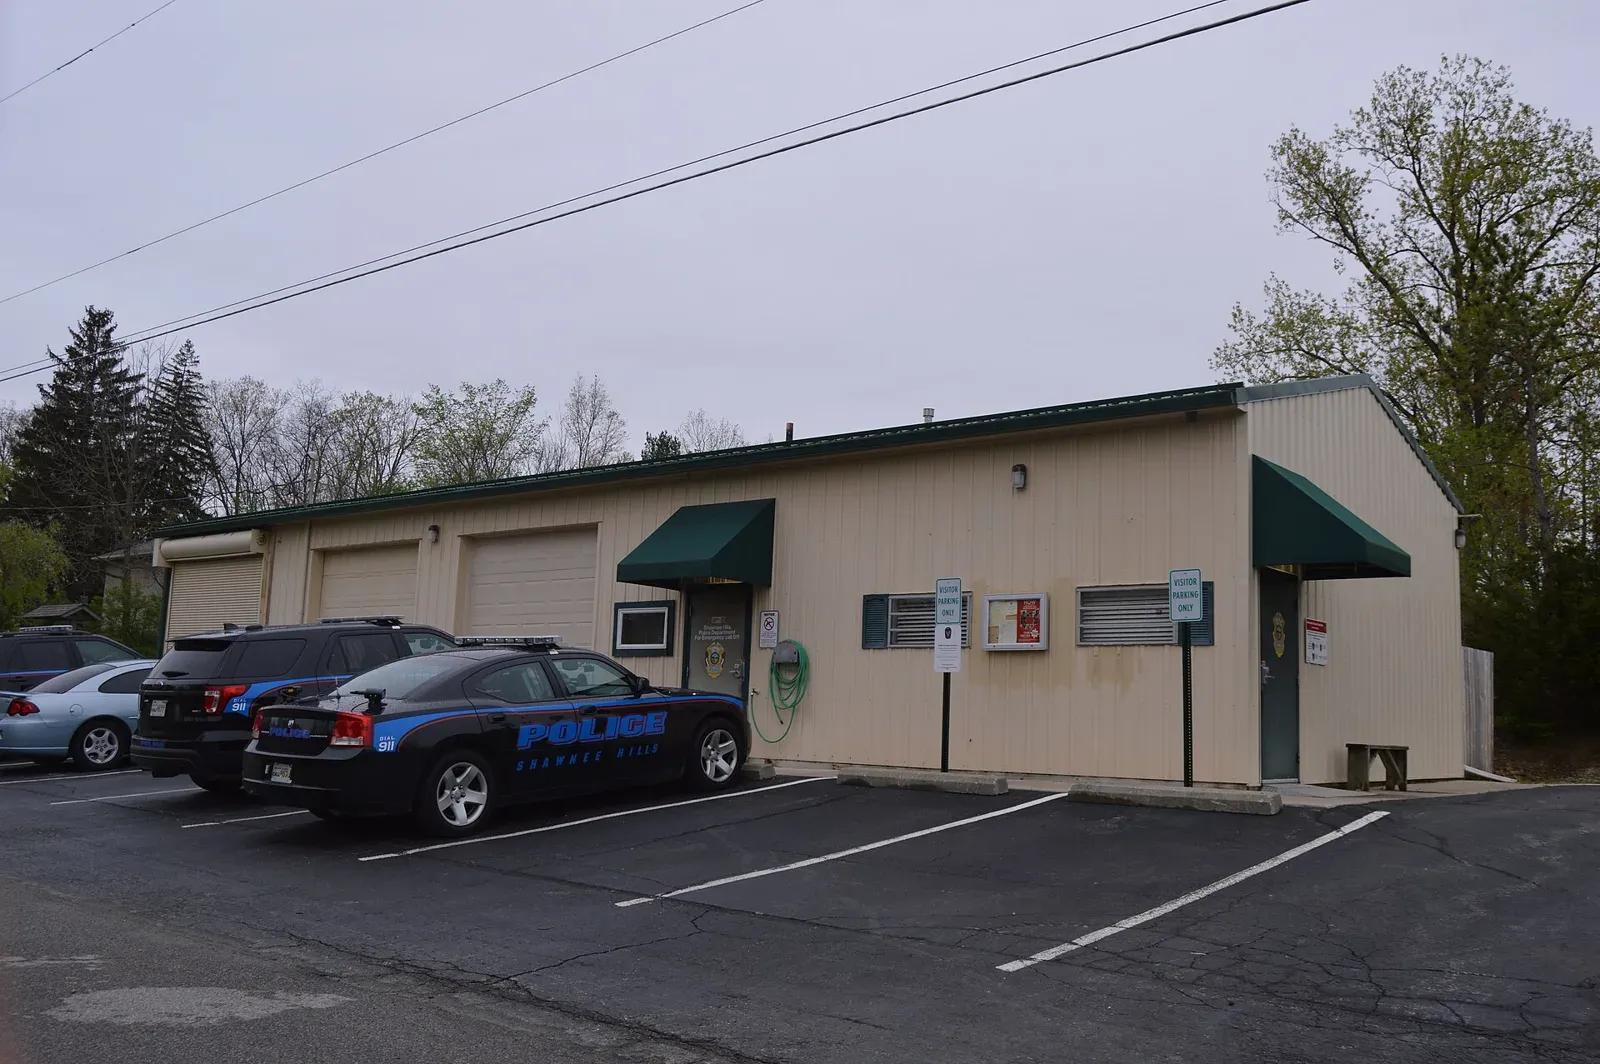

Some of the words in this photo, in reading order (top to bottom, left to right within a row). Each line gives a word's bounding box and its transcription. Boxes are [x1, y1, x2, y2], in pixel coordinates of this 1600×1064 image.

[1174, 578, 1197, 586] VISITOR
[1173, 591, 1198, 599] PARKING
[1178, 604, 1193, 612] ONLY
[232, 702, 246, 711] 911
[516, 711, 668, 750] POLICE
[378, 741, 394, 752] 911
[516, 750, 602, 771] SHAWNEE
[617, 744, 659, 758] HILLS
